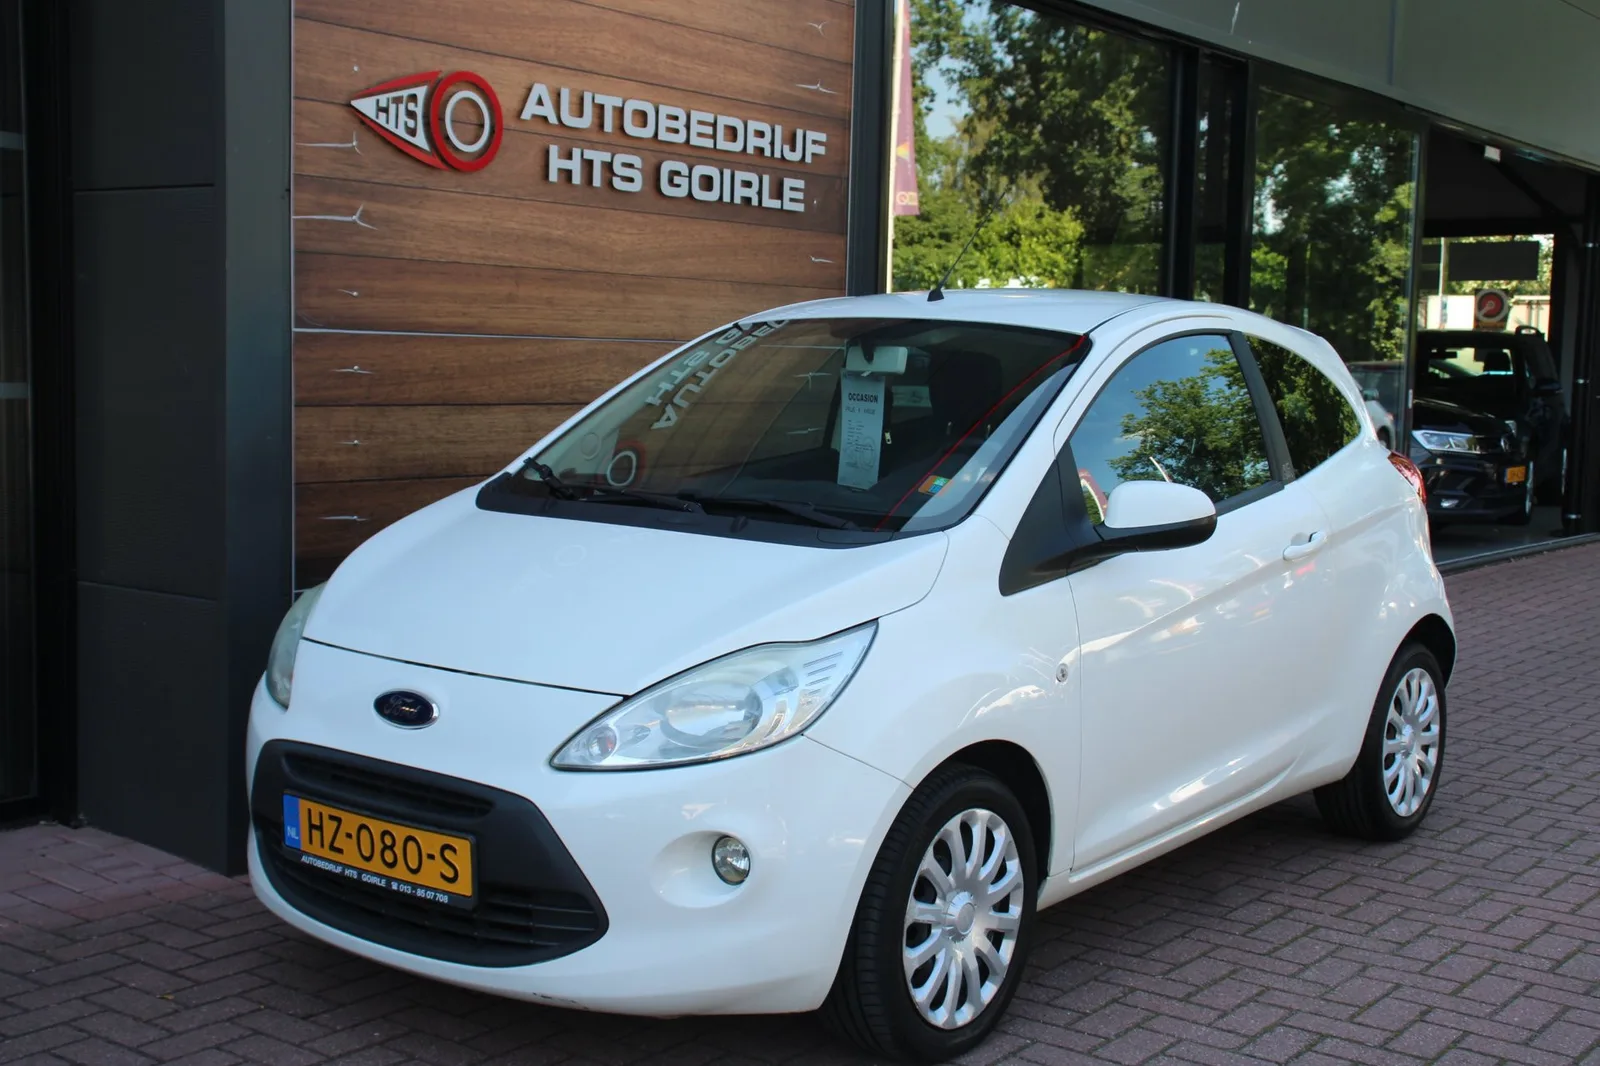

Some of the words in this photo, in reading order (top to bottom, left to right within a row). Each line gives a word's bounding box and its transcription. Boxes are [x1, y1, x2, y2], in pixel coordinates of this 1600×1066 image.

[374, 91, 420, 139] HTS
[520, 82, 827, 164] AUTOBEDRIJF
[548, 144, 643, 193] HTS
[659, 160, 806, 212] GOIRLE
[848, 392, 879, 404] OCCASION
[287, 826, 299, 840] NL
[307, 807, 459, 884] HZ-080-S
[300, 855, 343, 874] AUTOBEDRIJF
[344, 868, 358, 879] HTS
[361, 873, 387, 887] GOIRLE
[399, 884, 412, 894] 013
